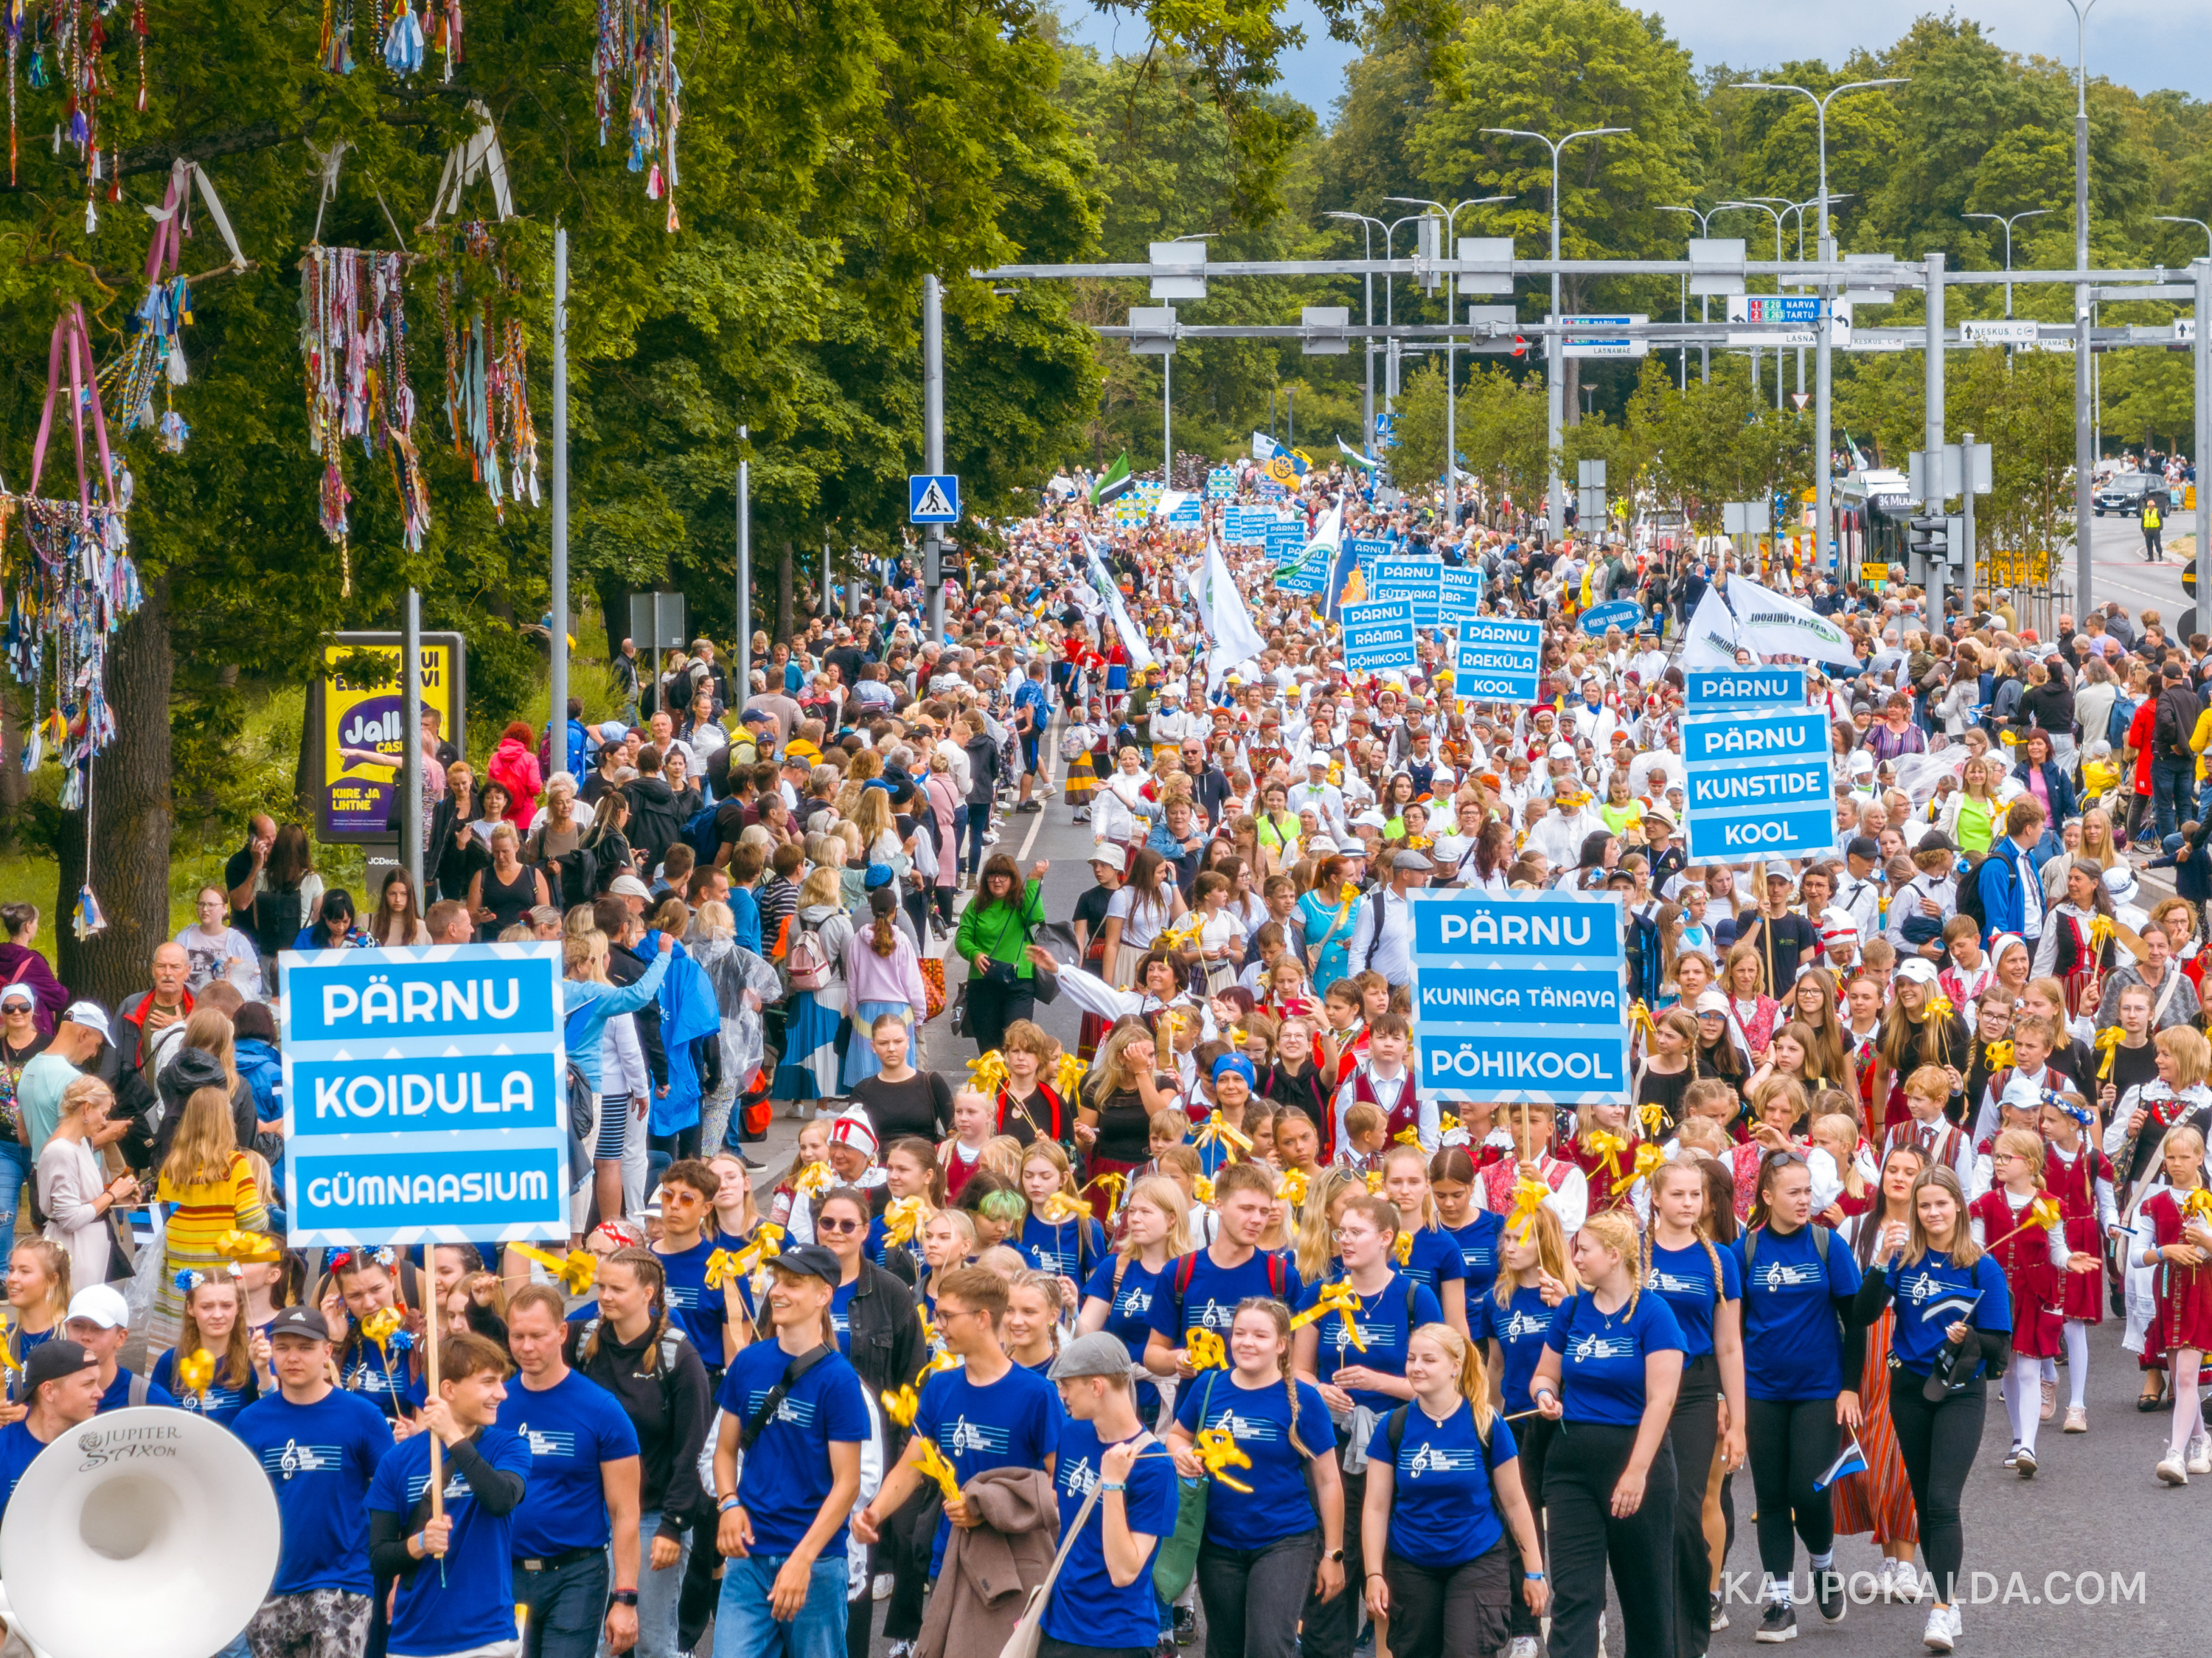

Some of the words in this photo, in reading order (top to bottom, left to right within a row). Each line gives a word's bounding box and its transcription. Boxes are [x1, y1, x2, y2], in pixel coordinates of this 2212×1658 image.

[1878, 496, 1889, 507] 34
[1270, 524, 1300, 533] PÄRNU
[1287, 547, 1324, 559] PÄU
[1355, 544, 1385, 553] ÄRNU
[1383, 566, 1433, 577] PÄRNU
[1443, 573, 1472, 585] RNU
[1288, 576, 1313, 589] KOOL
[1379, 589, 1436, 599] SÜTEVAKA
[1351, 606, 1403, 622] PÄRNU
[1587, 617, 1607, 628] PÄRNU
[1606, 610, 1635, 624] VABAKOOL
[1354, 629, 1403, 645] RÄÄMA
[1469, 625, 1530, 642] PÄRNU
[1349, 651, 1411, 668] PÕHIKOOL
[1462, 653, 1533, 670] RAEKÜLA
[395, 670, 439, 689] SVI
[1473, 679, 1517, 695] KOOL
[1702, 676, 1789, 698] PÄRNU
[344, 710, 401, 744] Jall
[376, 740, 403, 754] CASI
[1705, 726, 1806, 753] PÄRNU
[332, 788, 361, 799] KIIRE
[364, 788, 380, 799] JA
[1696, 771, 1821, 800] KUNSTIDE
[332, 799, 372, 811] LIHTNE
[1725, 821, 1798, 846] KOOL
[368, 857, 399, 865] JCDeca
[1440, 909, 1591, 946] PÄRNU
[323, 974, 520, 1026] PÄRNU
[1422, 988, 1520, 1006] KUNINGA
[1526, 986, 1615, 1008] TÄNAVA
[1431, 1043, 1613, 1079] PÕHIKOOL
[315, 1070, 534, 1119] KOIDULA
[307, 1170, 549, 1207] GÜMNAASIUM
[105, 1426, 181, 1446] JUPITER
[78, 1444, 177, 1472] SAXON
